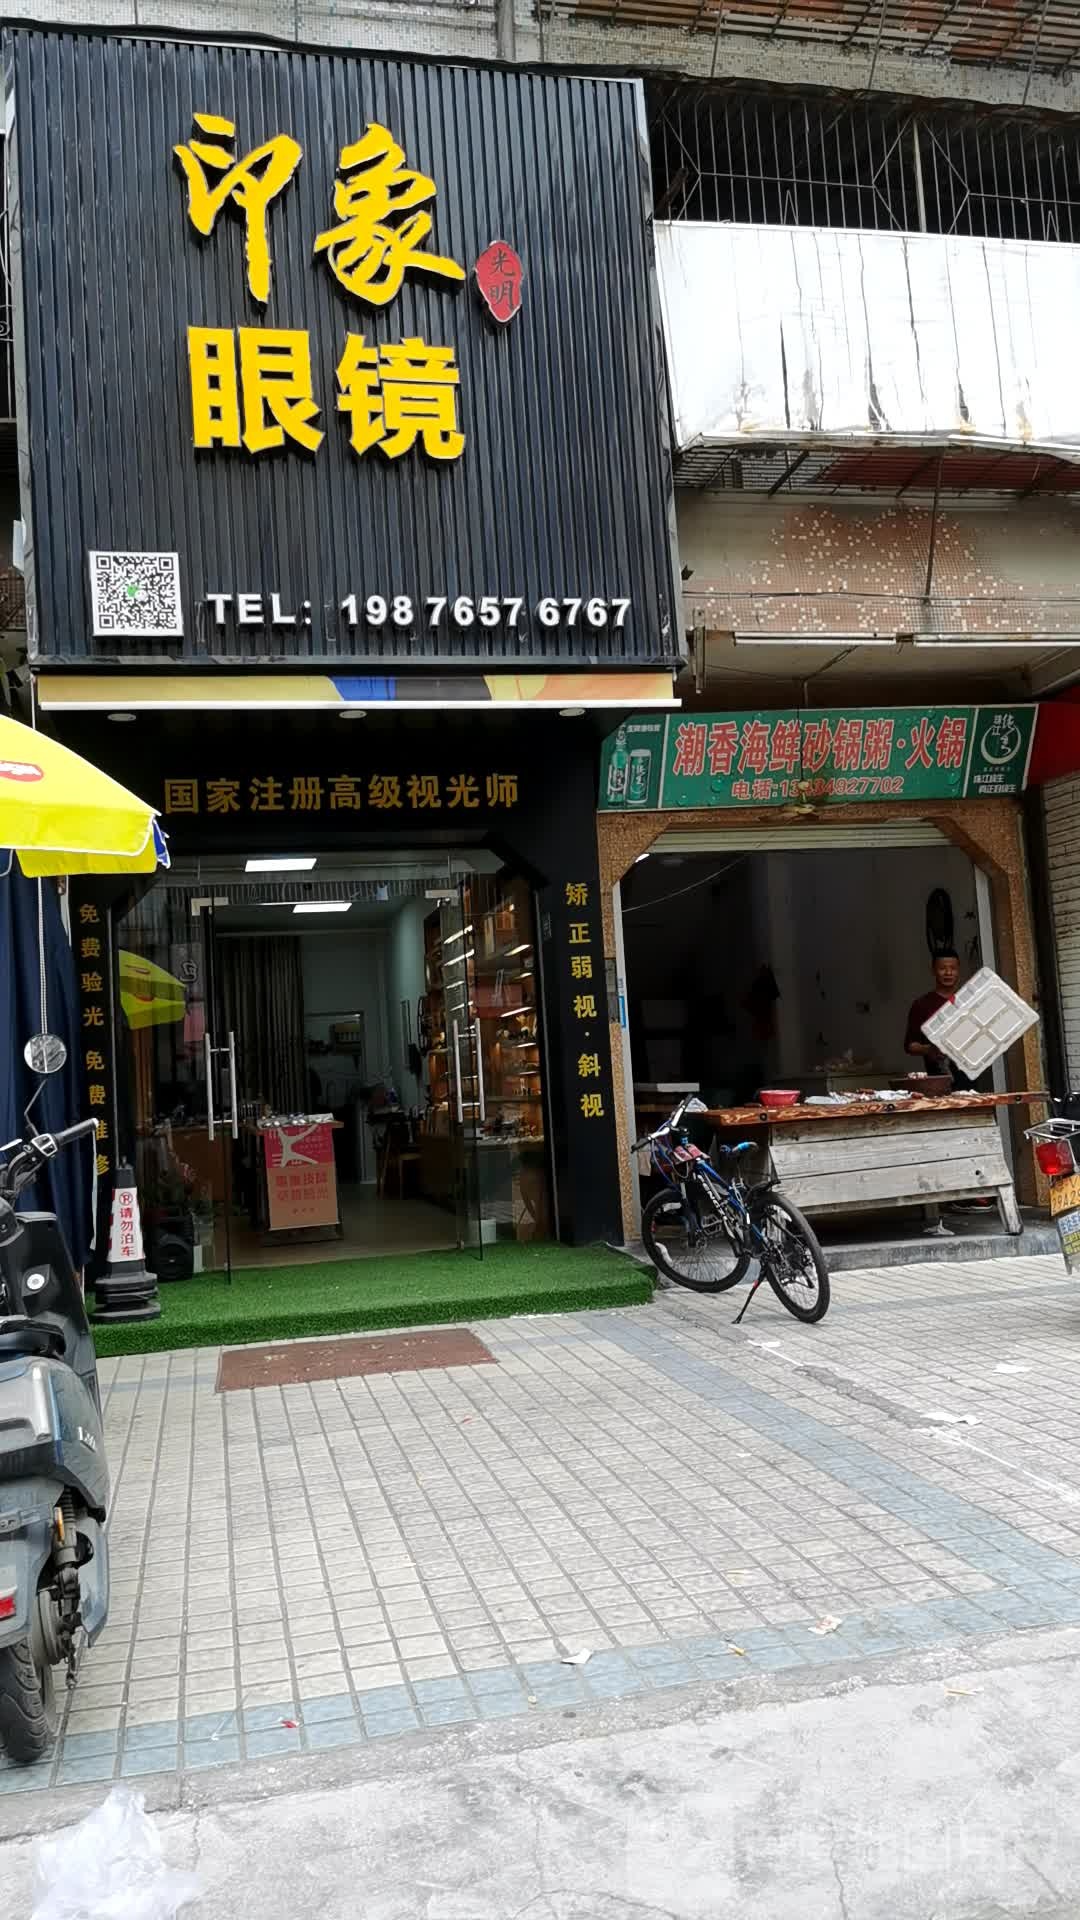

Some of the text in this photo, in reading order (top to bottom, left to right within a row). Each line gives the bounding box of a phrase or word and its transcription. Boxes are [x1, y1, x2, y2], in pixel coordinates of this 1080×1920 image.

[173, 112, 465, 305] 印象
[488, 247, 517, 311] 光明
[187, 326, 465, 459] 眼镜
[206, 593, 631, 627] TEL: 198 7657 6767
[672, 716, 968, 776] 潮香海鲜砂锅粥·火锅
[164, 773, 519, 814] 国家注册高级视光师
[79, 903, 104, 1027] 免费验光
[565, 882, 605, 1118] 矫正弱视·斜视
[120, 1207, 135, 1257] 请勿泊车
